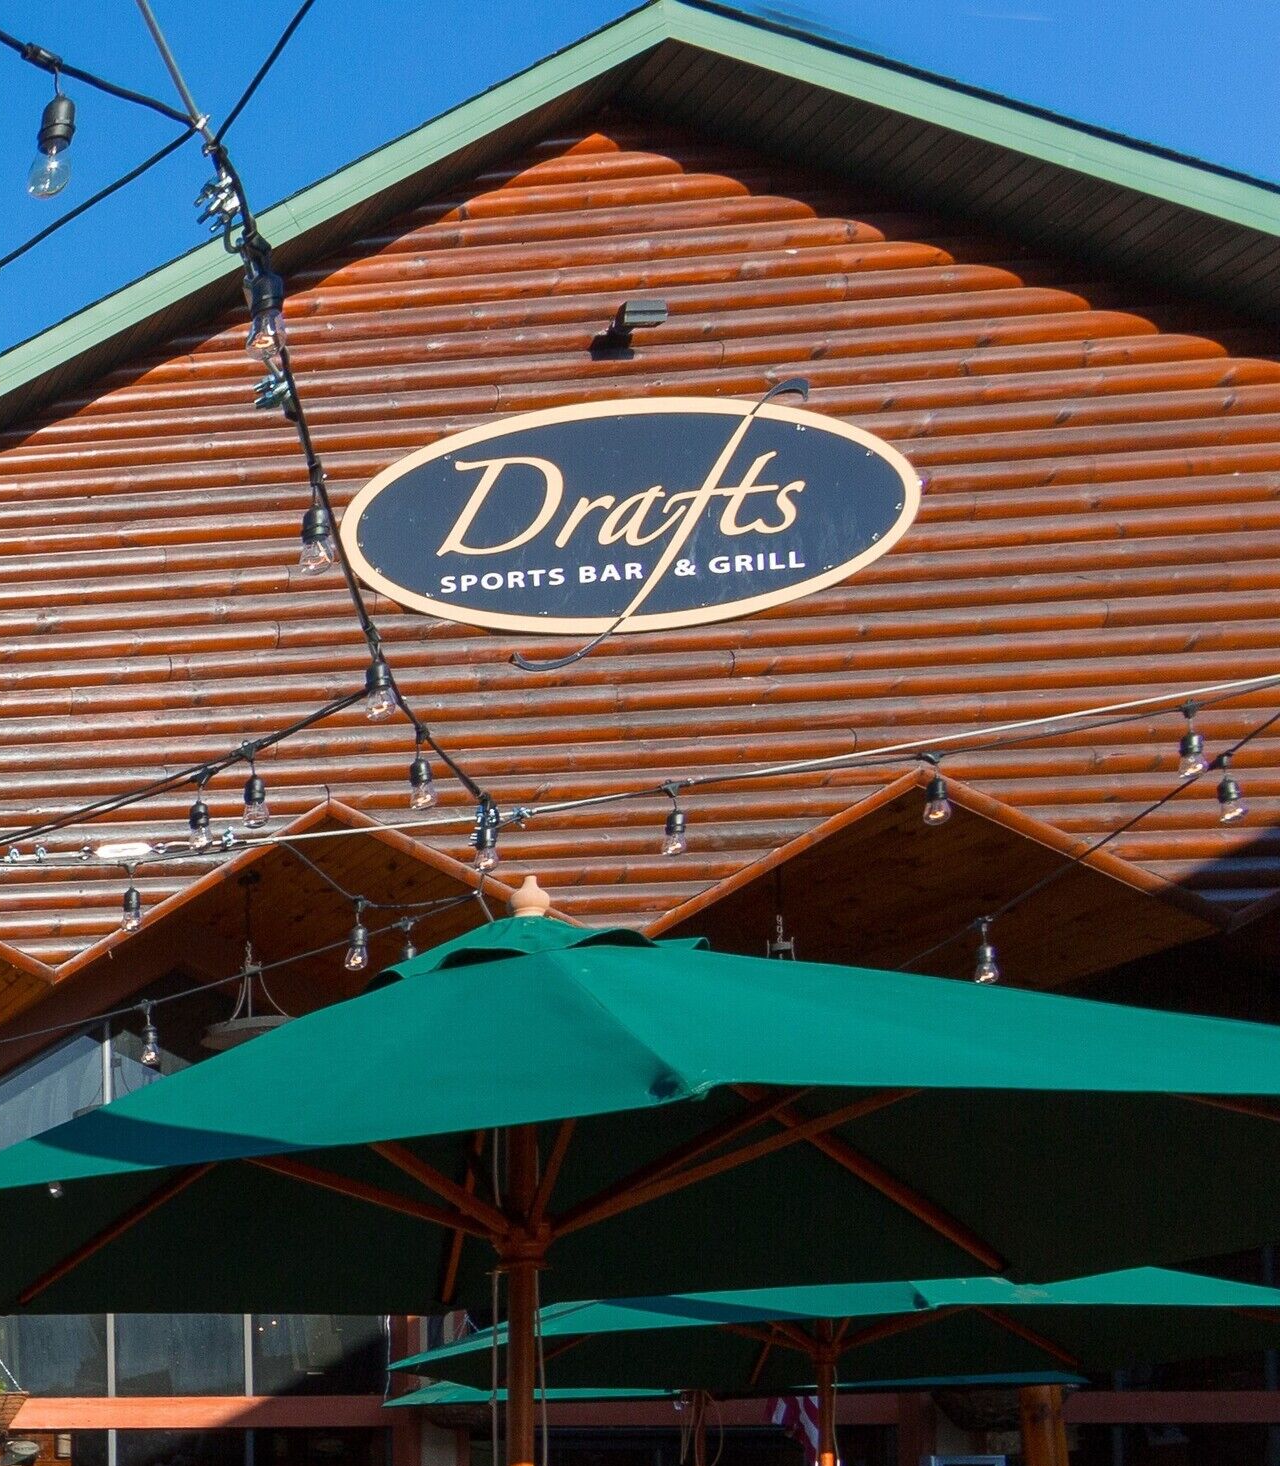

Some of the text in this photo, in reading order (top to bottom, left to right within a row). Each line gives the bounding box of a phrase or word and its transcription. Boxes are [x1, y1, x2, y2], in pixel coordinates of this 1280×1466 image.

[440, 551, 806, 594] SPORTS BAR & GRILL
